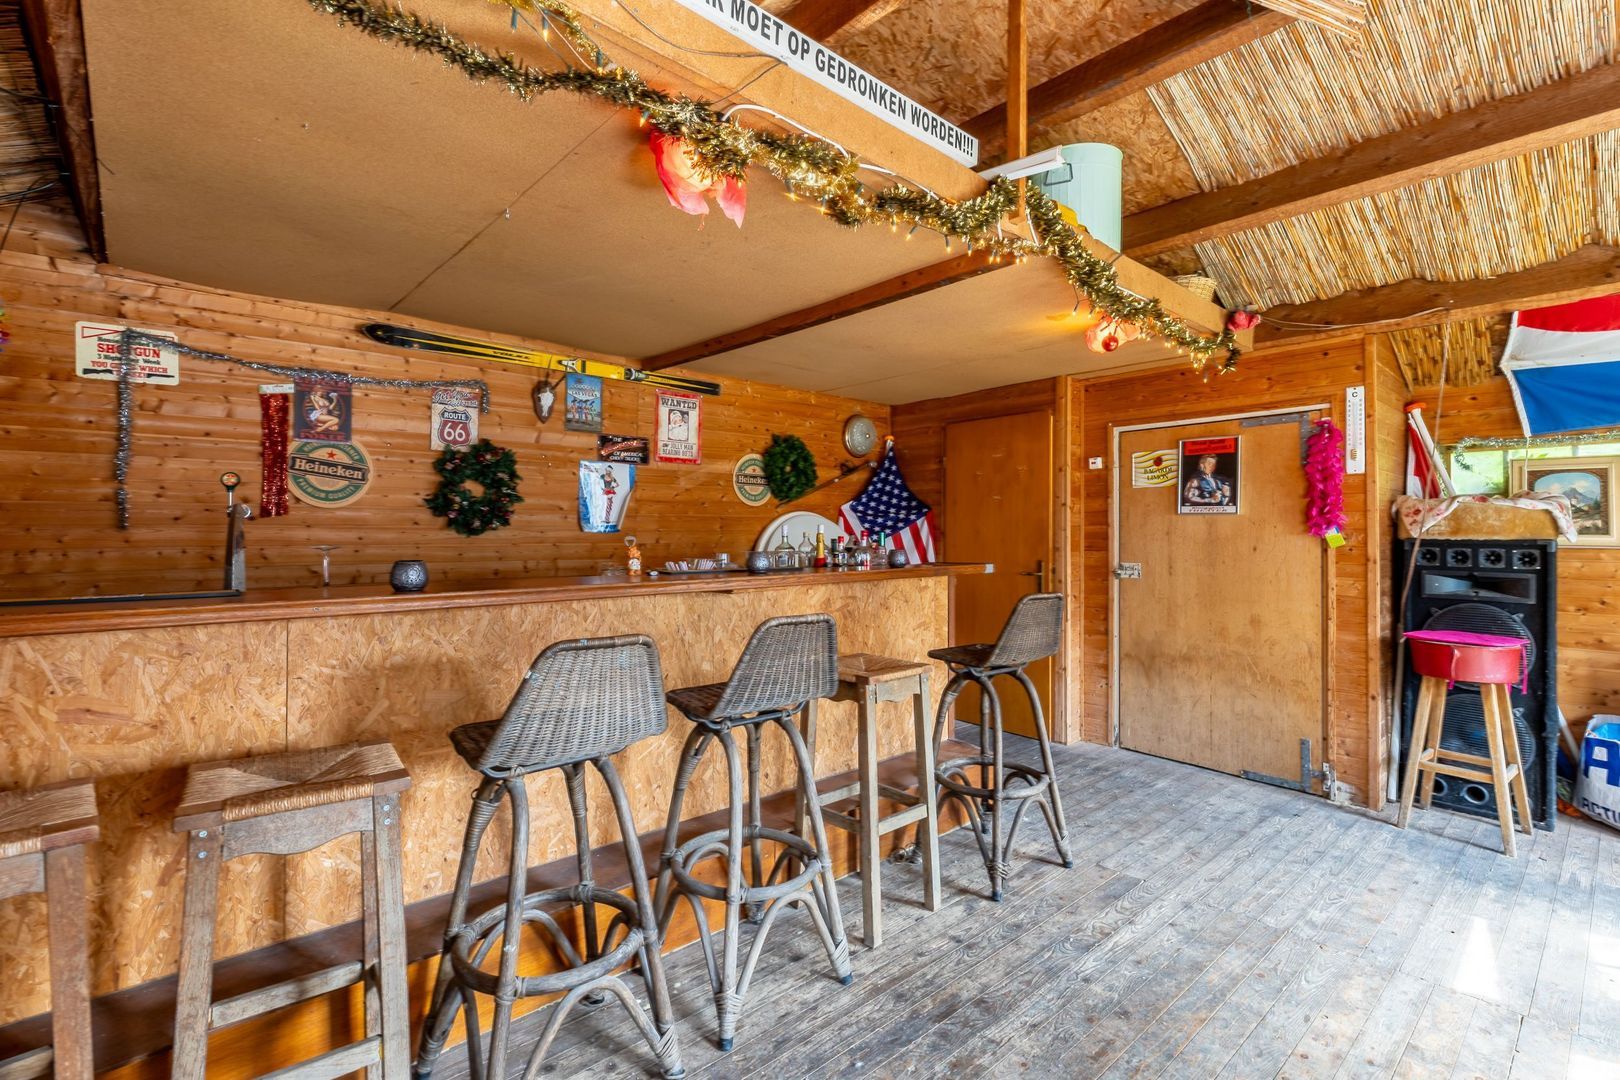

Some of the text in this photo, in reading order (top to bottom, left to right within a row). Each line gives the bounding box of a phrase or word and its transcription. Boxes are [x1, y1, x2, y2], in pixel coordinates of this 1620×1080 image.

[731, 0, 974, 157] MOET OP GEDRONKEN WORDEN!!!
[90, 360, 108, 368] YOU
[139, 365, 168, 374] WHICH
[661, 397, 697, 409] WANTED
[444, 412, 466, 420] ROUTE
[443, 422, 466, 442] 66
[294, 459, 363, 479] Heineken
[738, 475, 767, 484] Heineke
[1582, 797, 1620, 825] ACTI
